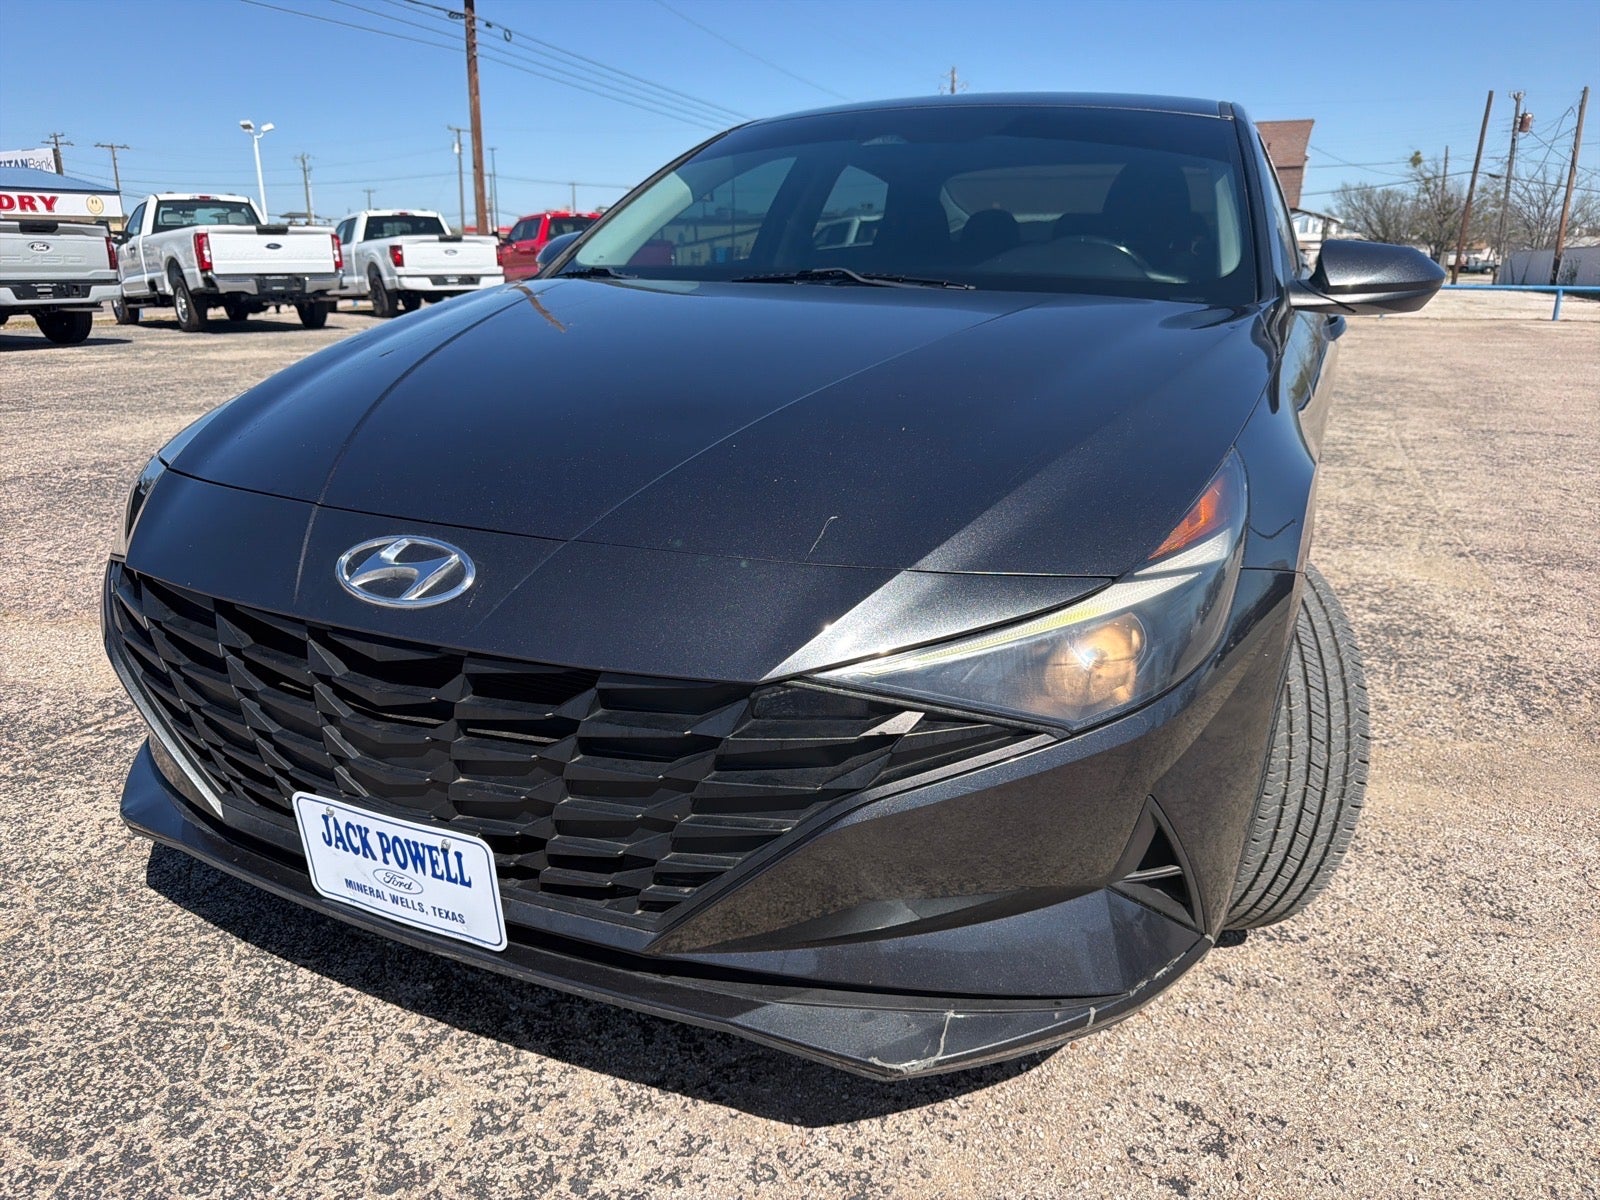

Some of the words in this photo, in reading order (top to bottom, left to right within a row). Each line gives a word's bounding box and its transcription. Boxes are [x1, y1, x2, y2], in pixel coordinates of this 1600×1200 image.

[321, 814, 377, 861] JACK
[376, 831, 472, 888] POWELL
[344, 878, 388, 902] MINERAL
[389, 892, 429, 915] WELLS,
[430, 906, 466, 925] TEXAS
[382, 870, 414, 891] Ford
